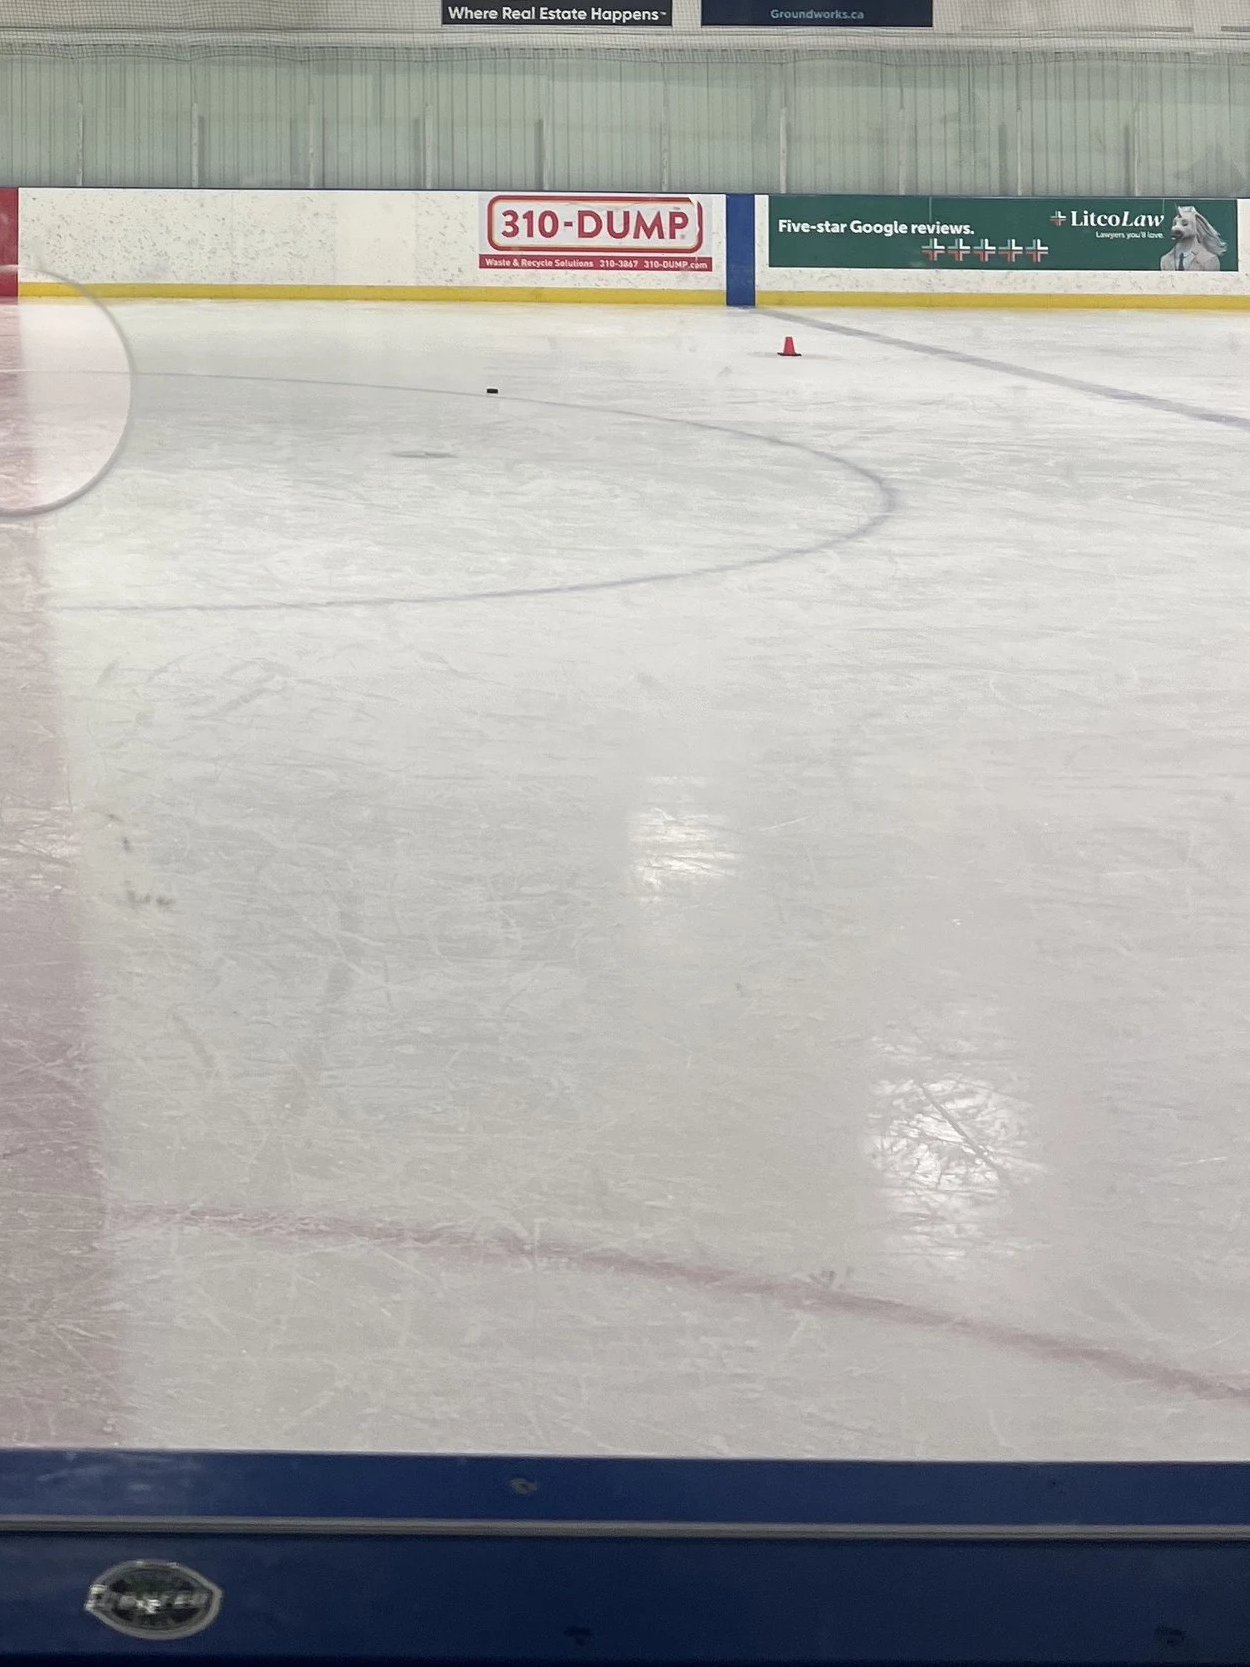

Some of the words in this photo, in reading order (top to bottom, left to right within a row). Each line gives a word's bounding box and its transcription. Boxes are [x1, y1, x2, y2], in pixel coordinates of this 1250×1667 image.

[448, 6, 498, 20] Where
[502, 6, 536, 20] Real
[539, 7, 587, 21] Estate
[770, 9, 865, 20] Groundworks.ca
[501, 209, 689, 240] 310-DUMP
[1070, 210, 1165, 227] LitcoLaw
[778, 219, 847, 234] Five-star
[849, 220, 908, 237] Google
[910, 221, 975, 235] reviews.
[1096, 231, 1125, 239] Lawyers
[485, 258, 510, 266] Waste
[512, 258, 519, 266] &
[521, 258, 553, 268] Recycle
[554, 259, 594, 267] Solutions
